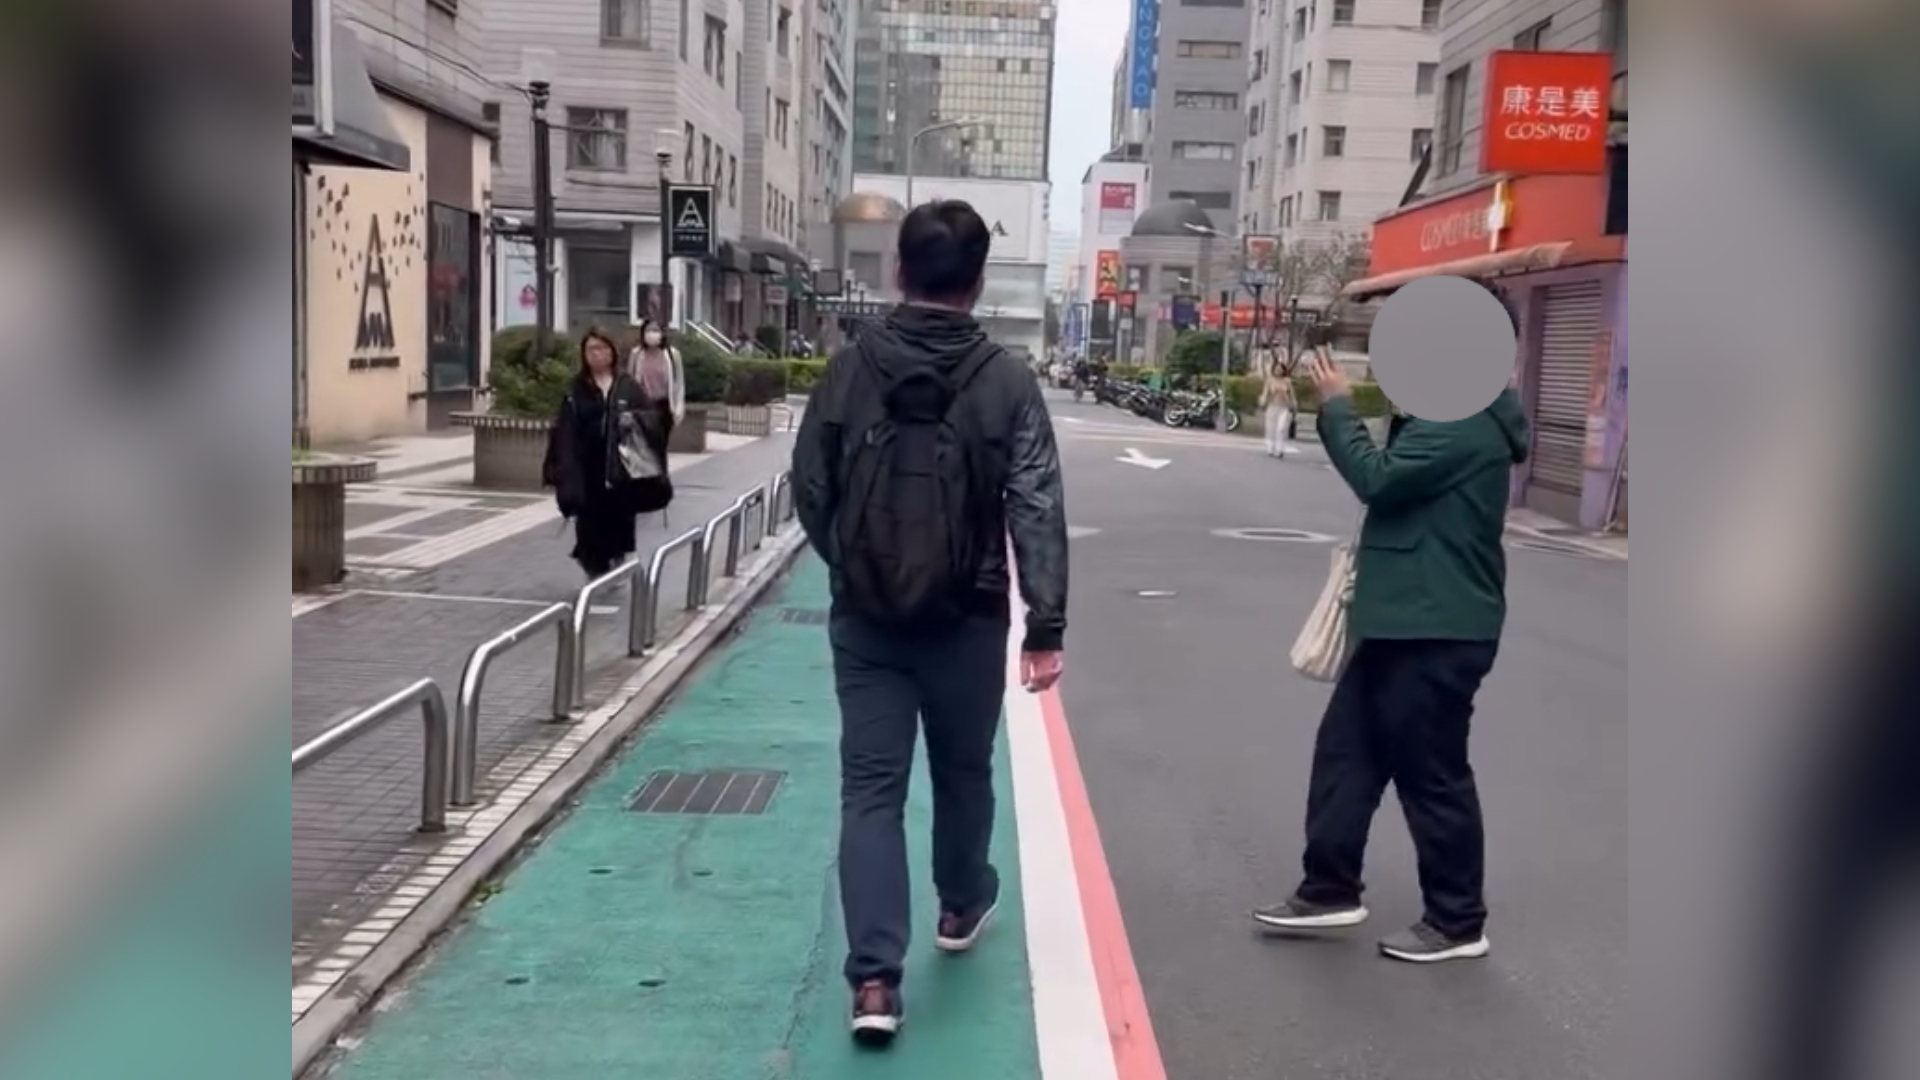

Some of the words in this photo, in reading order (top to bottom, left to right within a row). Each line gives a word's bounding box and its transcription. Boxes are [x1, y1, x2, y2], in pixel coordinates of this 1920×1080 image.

[1501, 84, 1600, 119] 康是美
[1505, 121, 1591, 141] COSMED
